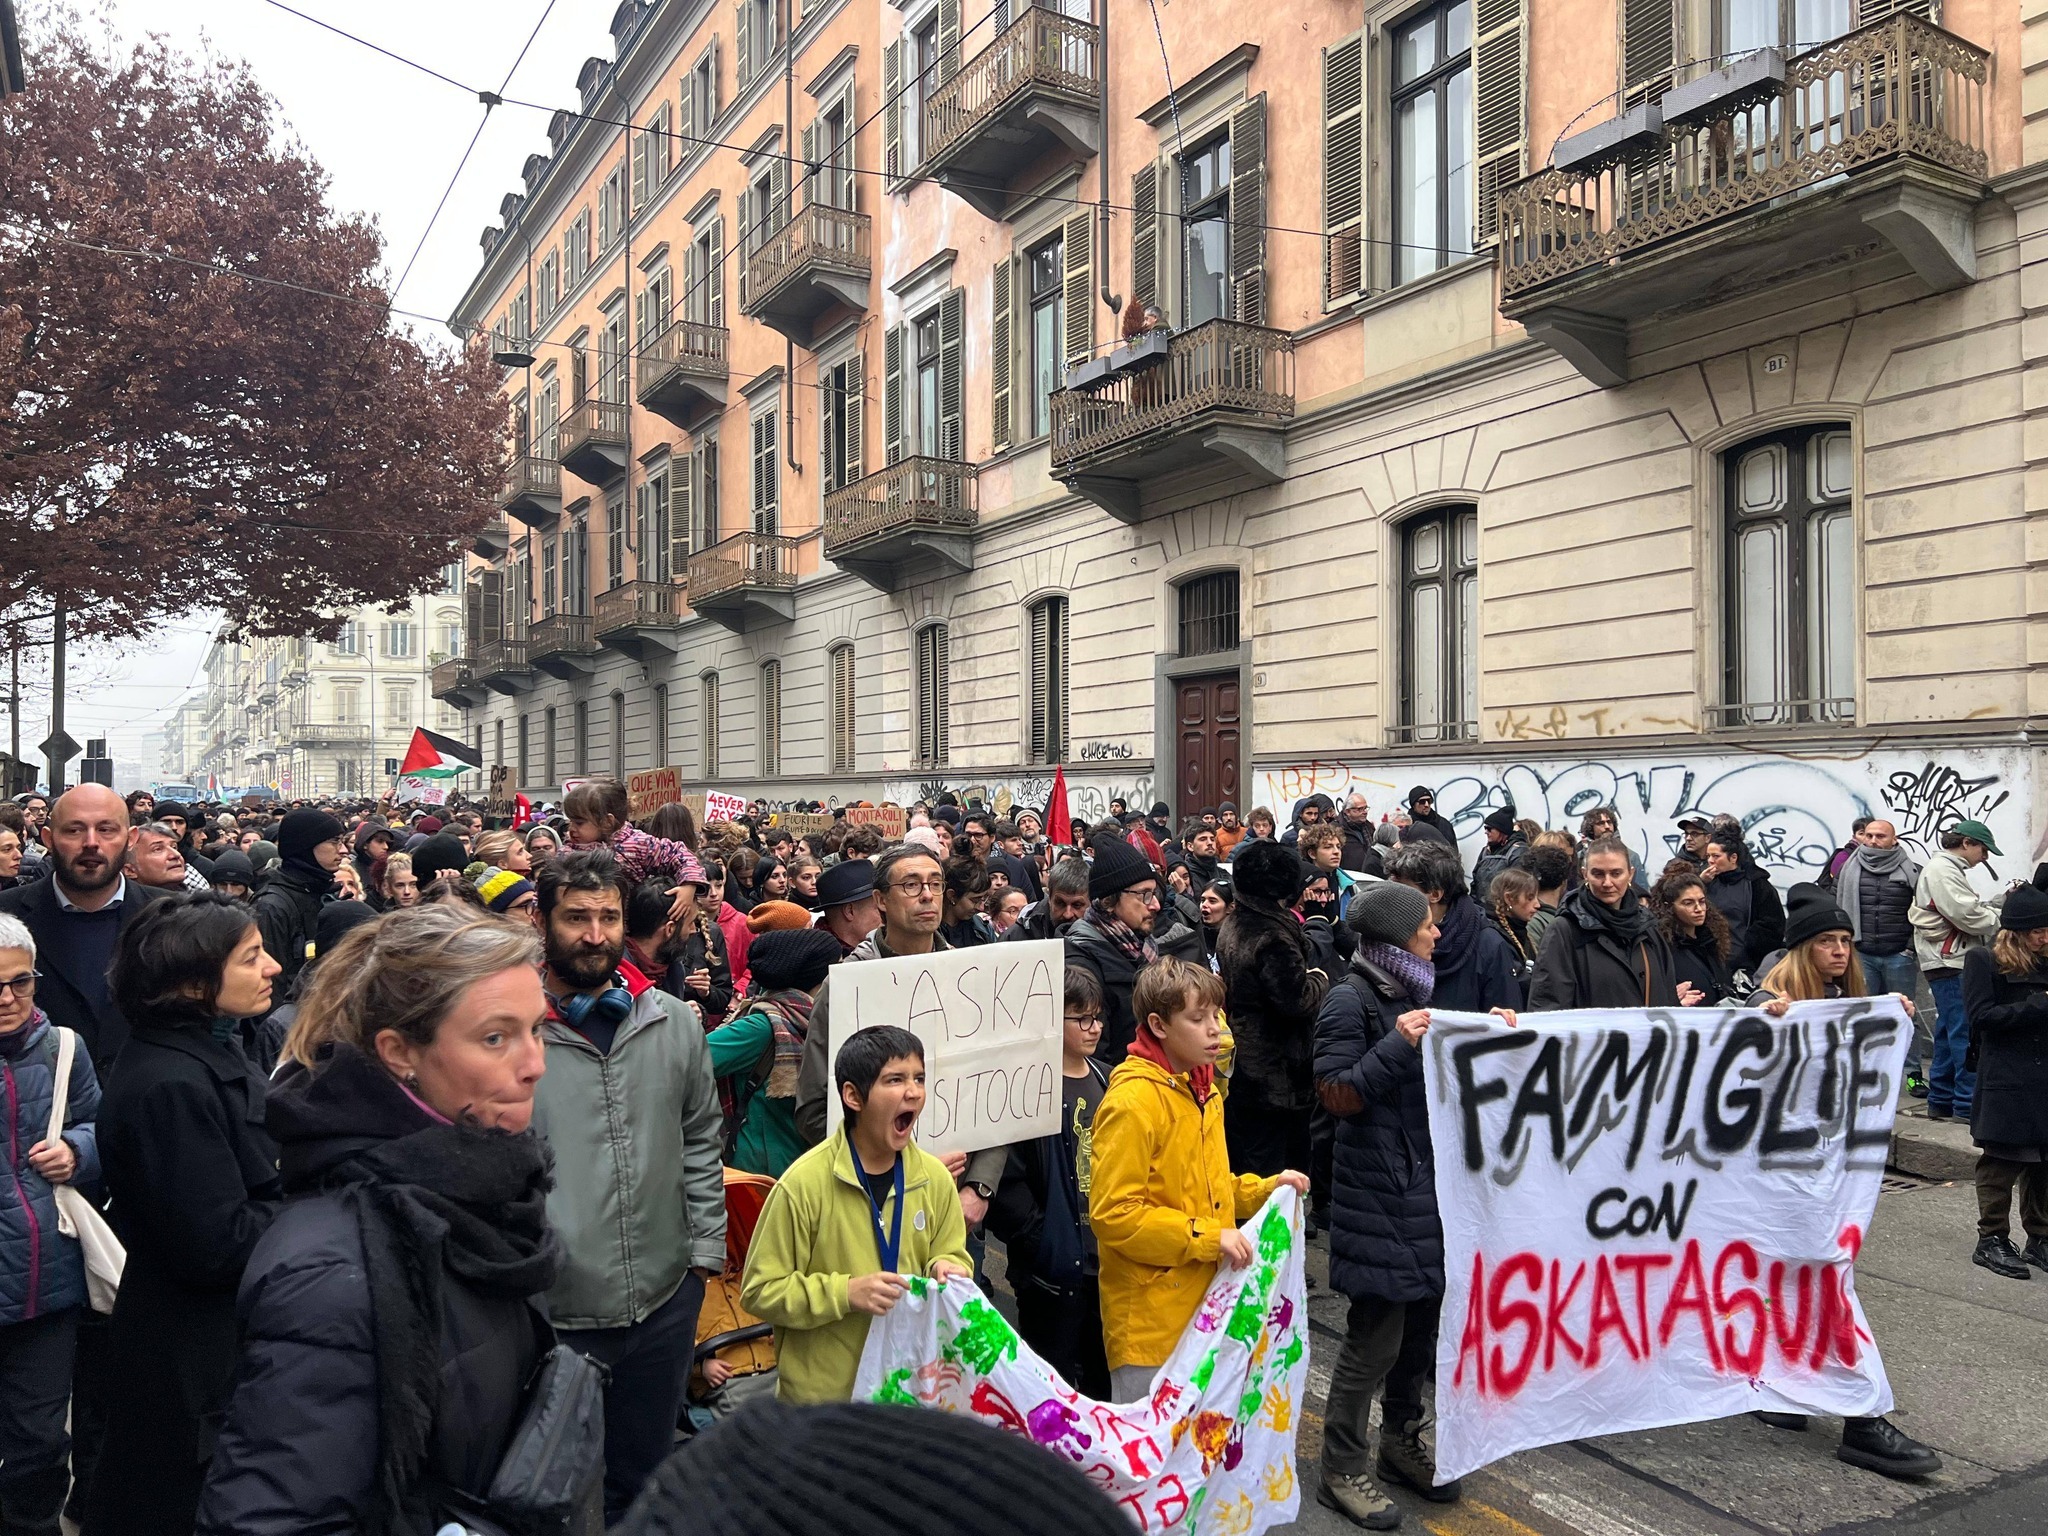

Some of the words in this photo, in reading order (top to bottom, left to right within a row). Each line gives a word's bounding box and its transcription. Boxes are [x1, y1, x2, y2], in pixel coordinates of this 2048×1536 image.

[631, 776, 653, 793] QUE
[655, 770, 676, 791] VIVA
[639, 786, 682, 813] SKATASUNA
[708, 793, 744, 813] 4EVER
[784, 814, 810, 825] FUORI
[812, 816, 822, 825] LE
[848, 808, 902, 824] MONTARULI
[1452, 1014, 1900, 1173] FAMIGLIE
